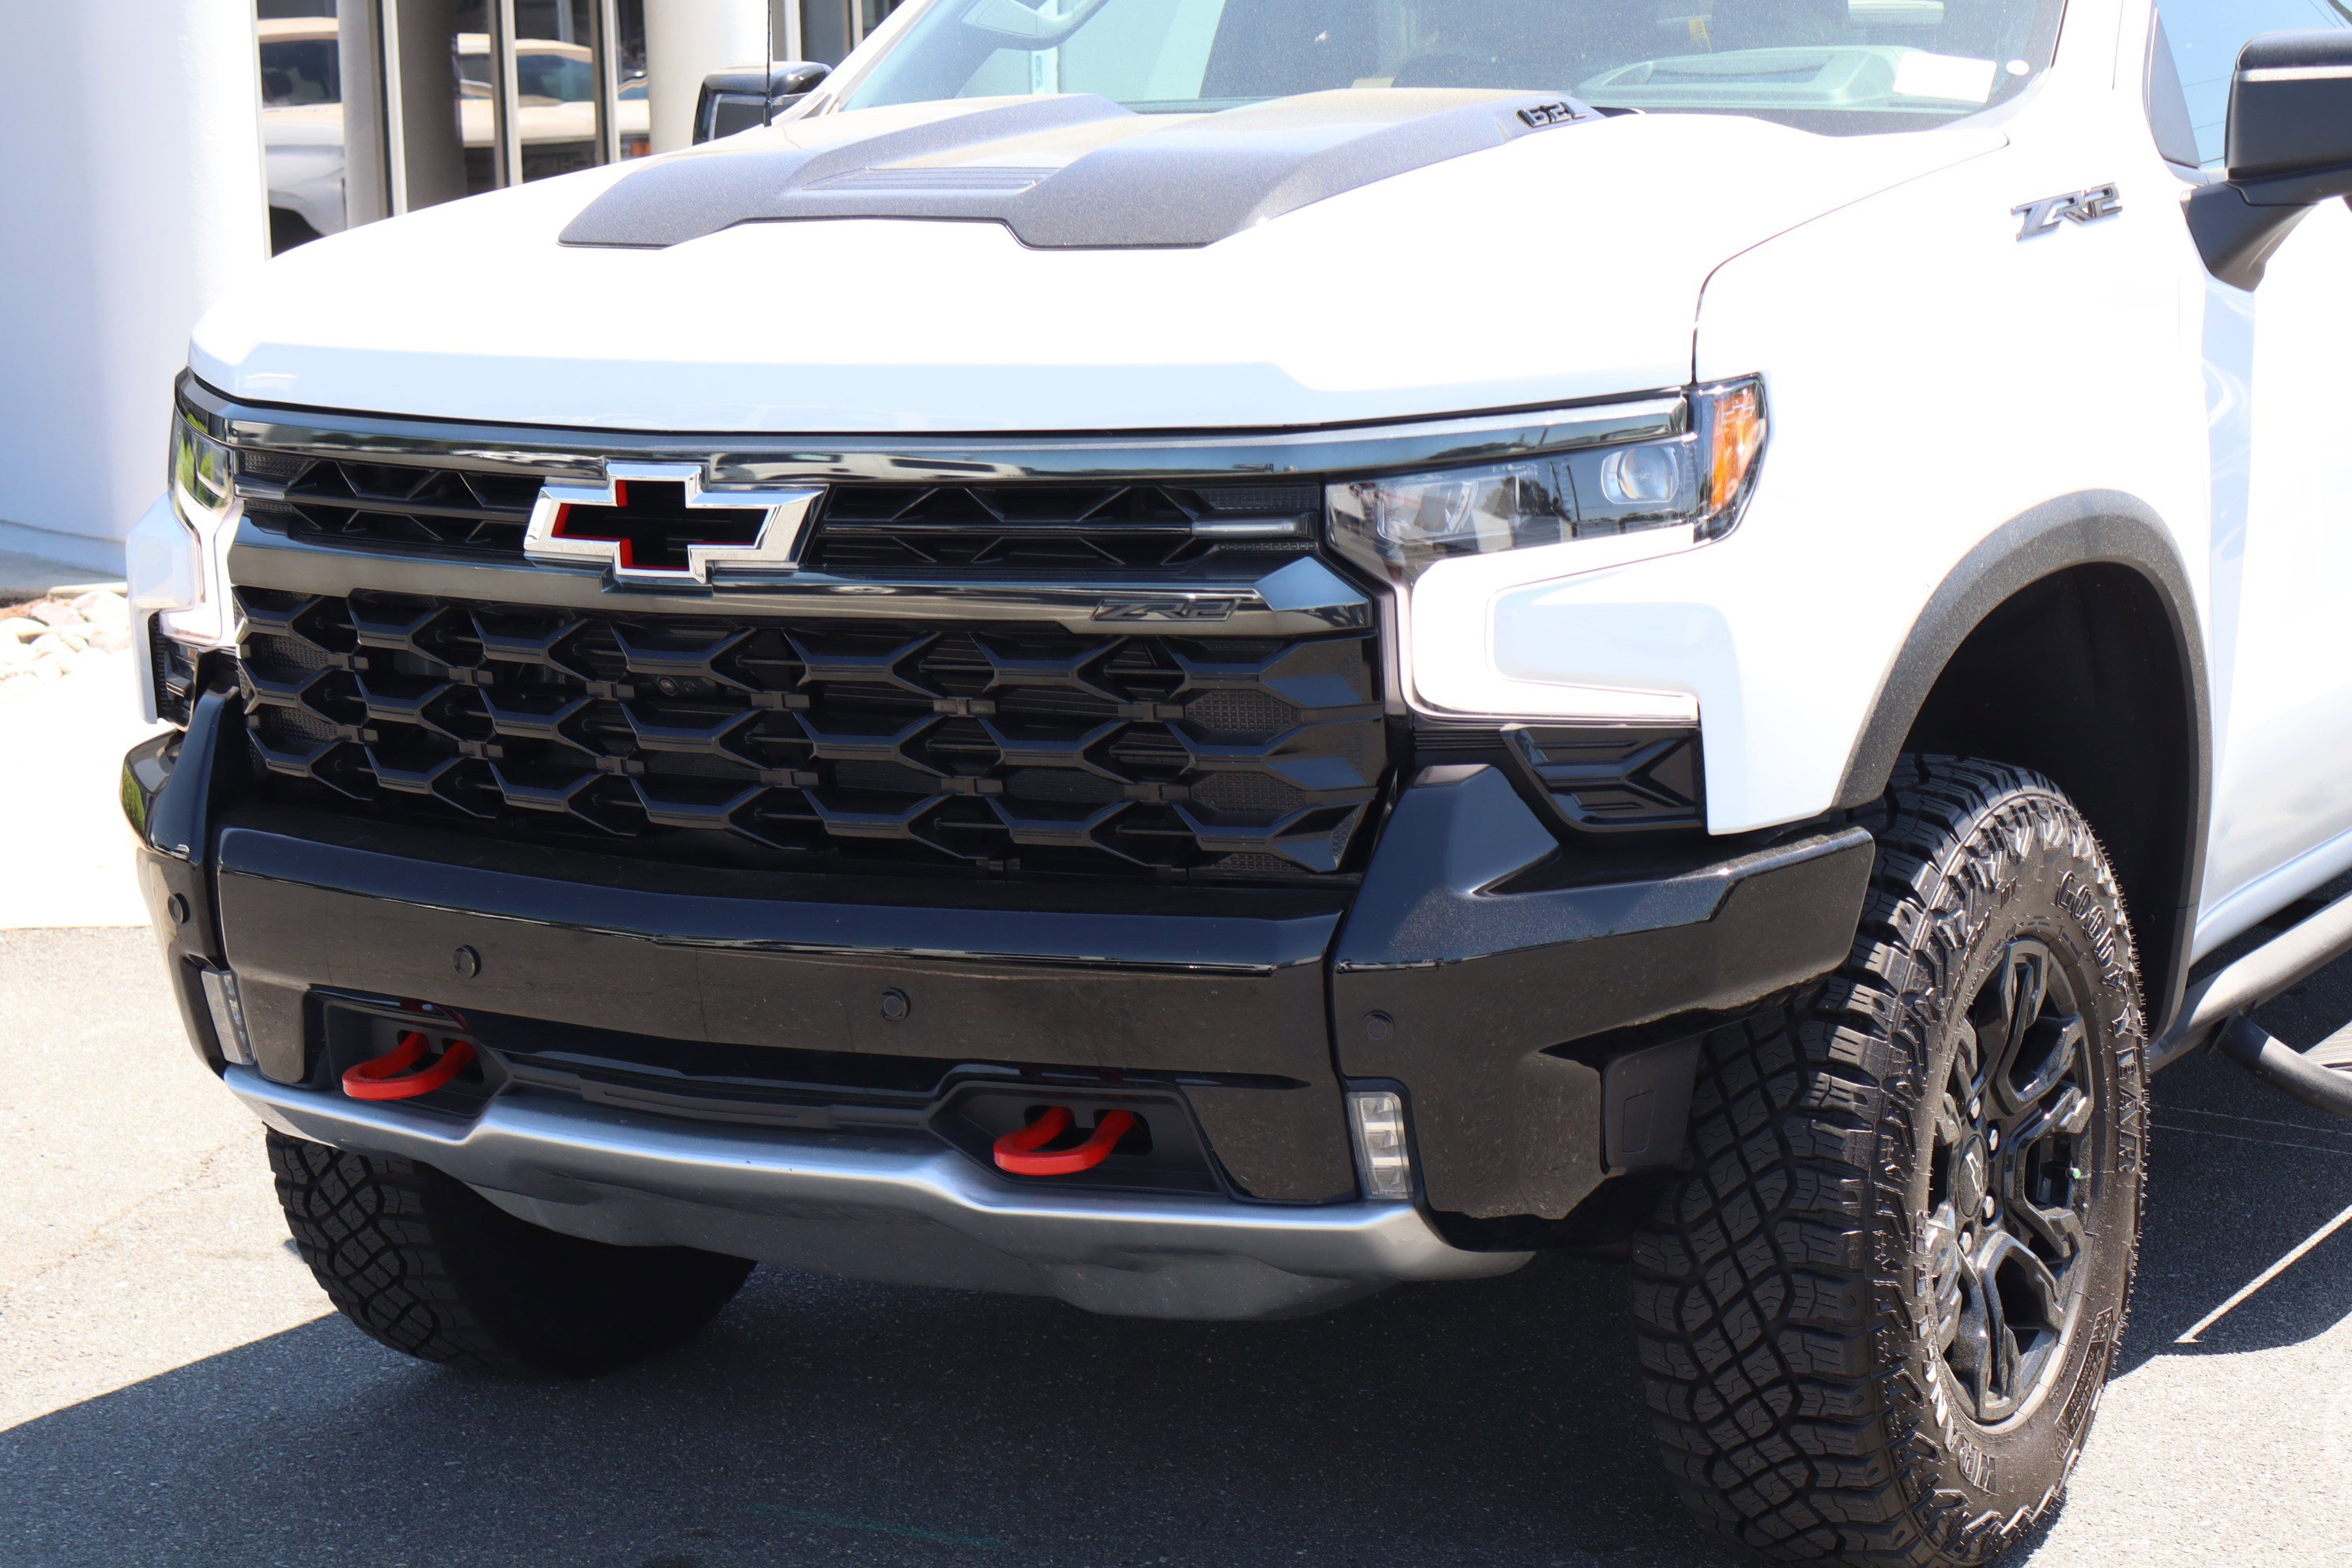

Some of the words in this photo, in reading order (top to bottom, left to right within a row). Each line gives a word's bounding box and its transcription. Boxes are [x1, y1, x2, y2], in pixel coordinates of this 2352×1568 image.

[2011, 182, 2123, 242] ZR2
[1101, 601, 1236, 620] ZR2
[2056, 870, 2141, 1173] GOODYEAR
[1915, 1209, 1999, 1496] WRANGLER
